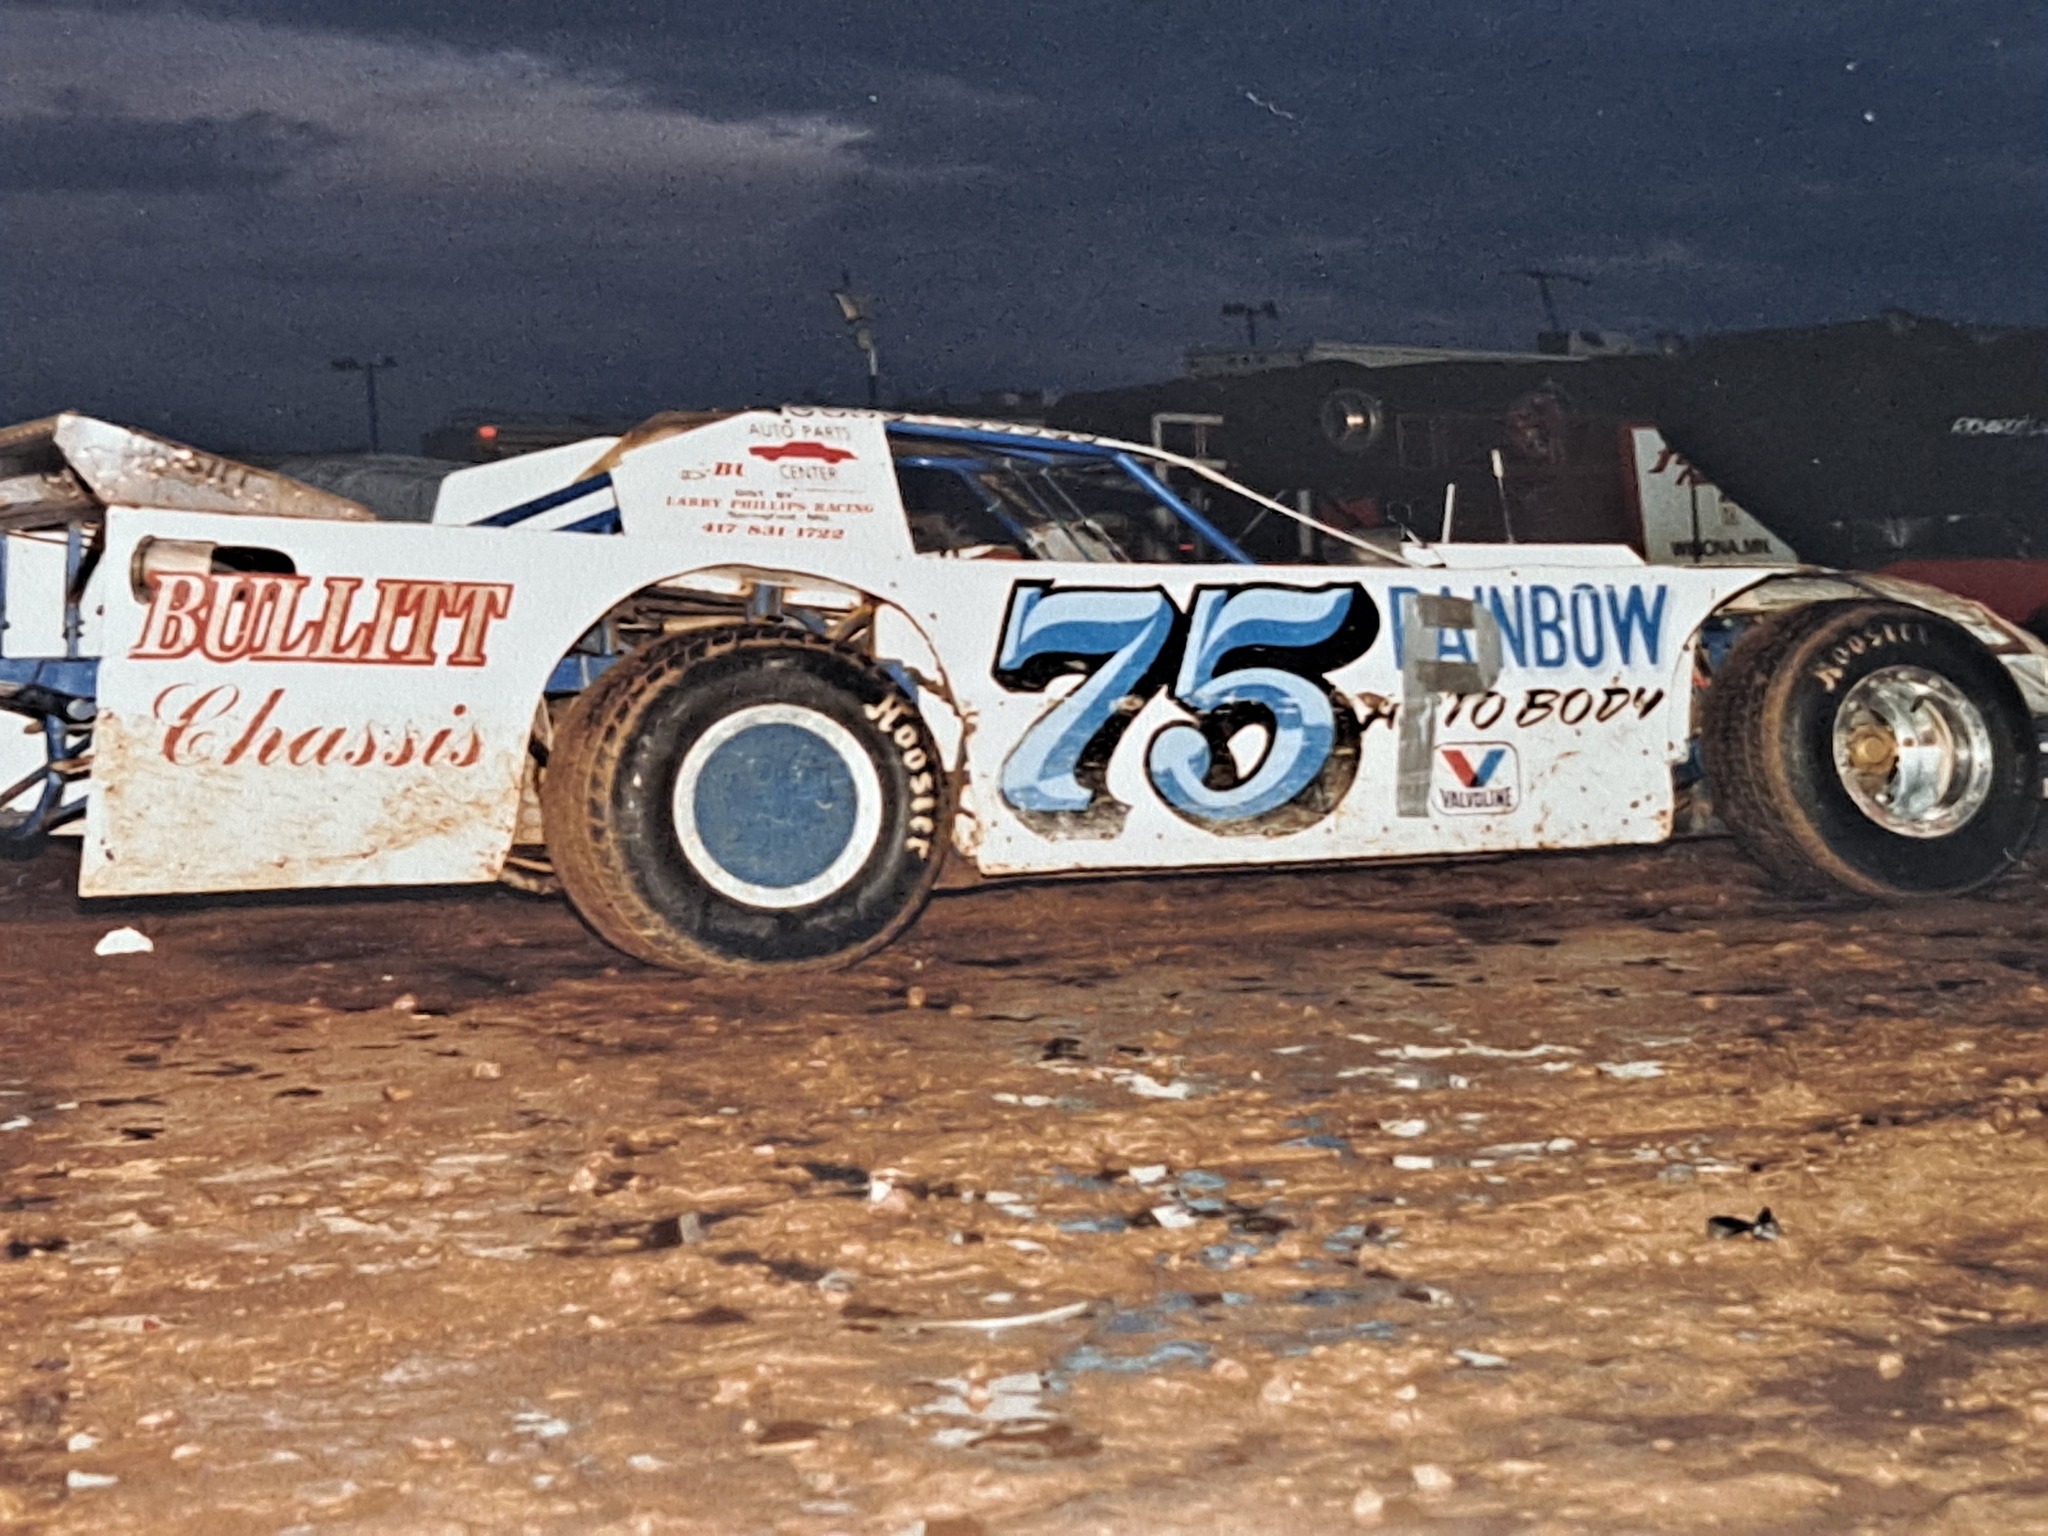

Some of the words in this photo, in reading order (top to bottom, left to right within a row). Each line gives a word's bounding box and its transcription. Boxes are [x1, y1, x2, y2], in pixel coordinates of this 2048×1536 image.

[749, 422, 794, 439] AUTO
[802, 425, 851, 441] PARTS
[779, 463, 838, 481] CENTER
[666, 496, 721, 508] LARRY
[730, 499, 807, 512] PHILLIPS
[814, 502, 874, 514] RACING
[702, 522, 738, 535] 417
[797, 527, 844, 540] 1722
[128, 571, 515, 668] BULLITT
[1387, 584, 1669, 671] ANBOW
[153, 683, 486, 768] Chassis
[991, 578, 1381, 840] 75
[1357, 690, 1507, 731] ATO
[1515, 686, 1666, 729] BODY
[1439, 786, 1512, 809] VALVOLINE
